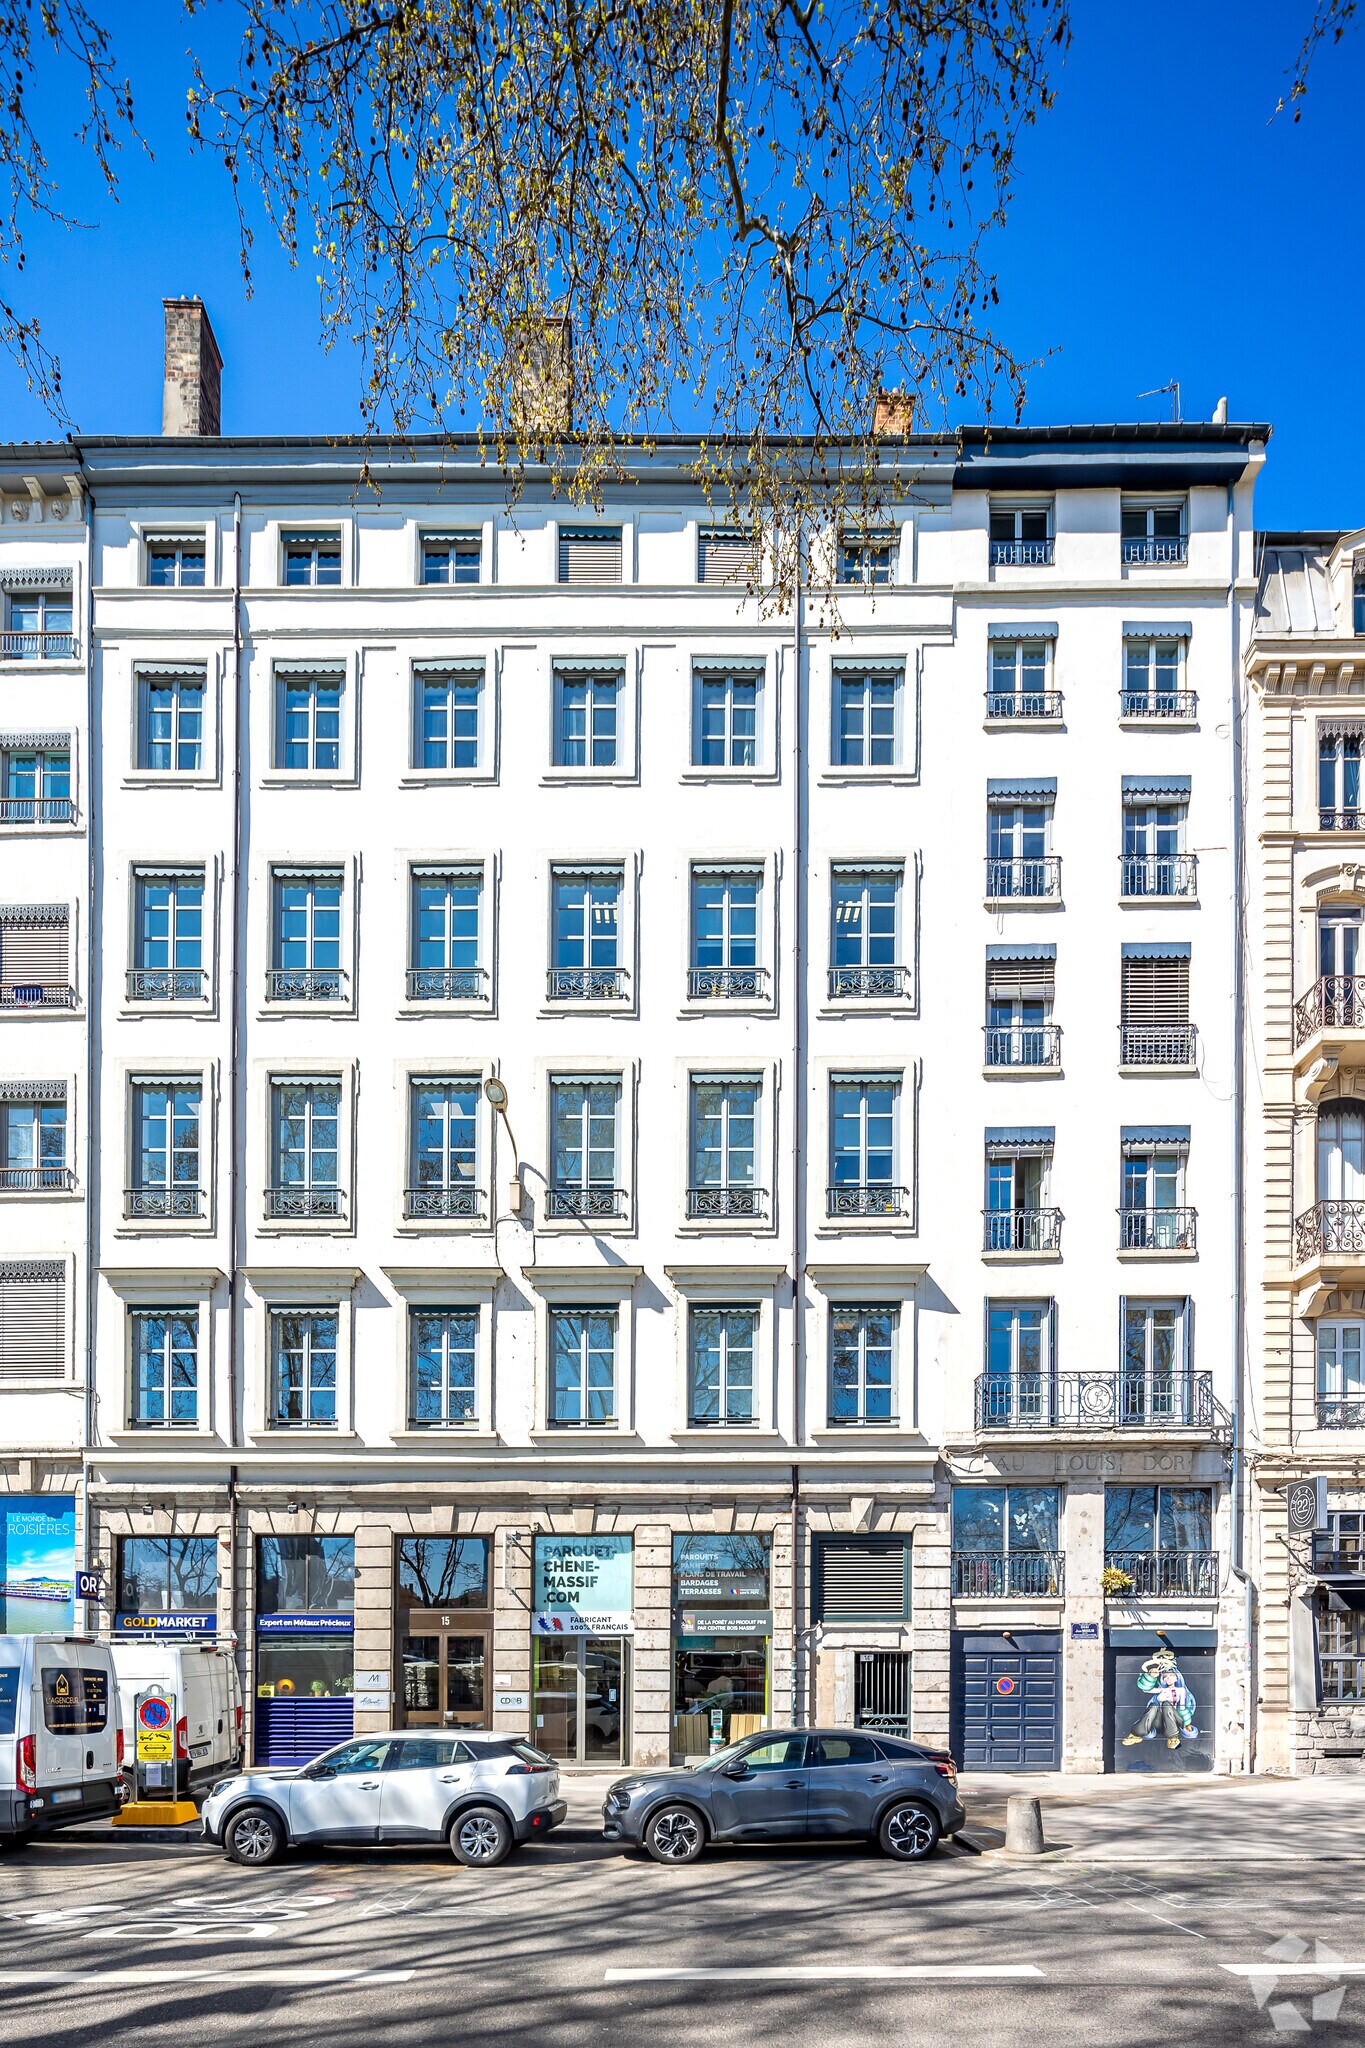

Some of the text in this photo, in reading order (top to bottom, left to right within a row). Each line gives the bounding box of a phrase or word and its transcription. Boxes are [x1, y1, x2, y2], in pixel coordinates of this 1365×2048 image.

[996, 1455, 1025, 1471] AU
[1055, 1455, 1115, 1471] LOUIS
[1297, 1498, 1308, 1513] 22
[543, 1545, 618, 1557] PARQUET-
[543, 1560, 600, 1573] CHENE-
[80, 1575, 97, 1593] OR
[543, 1576, 599, 1588] MASSIF
[543, 1591, 580, 1603] .COM
[123, 1617, 208, 1628] GOLDMARKET
[259, 1619, 284, 1627] Expert
[320, 1619, 351, 1627] Précieux
[441, 1616, 450, 1626] 15
